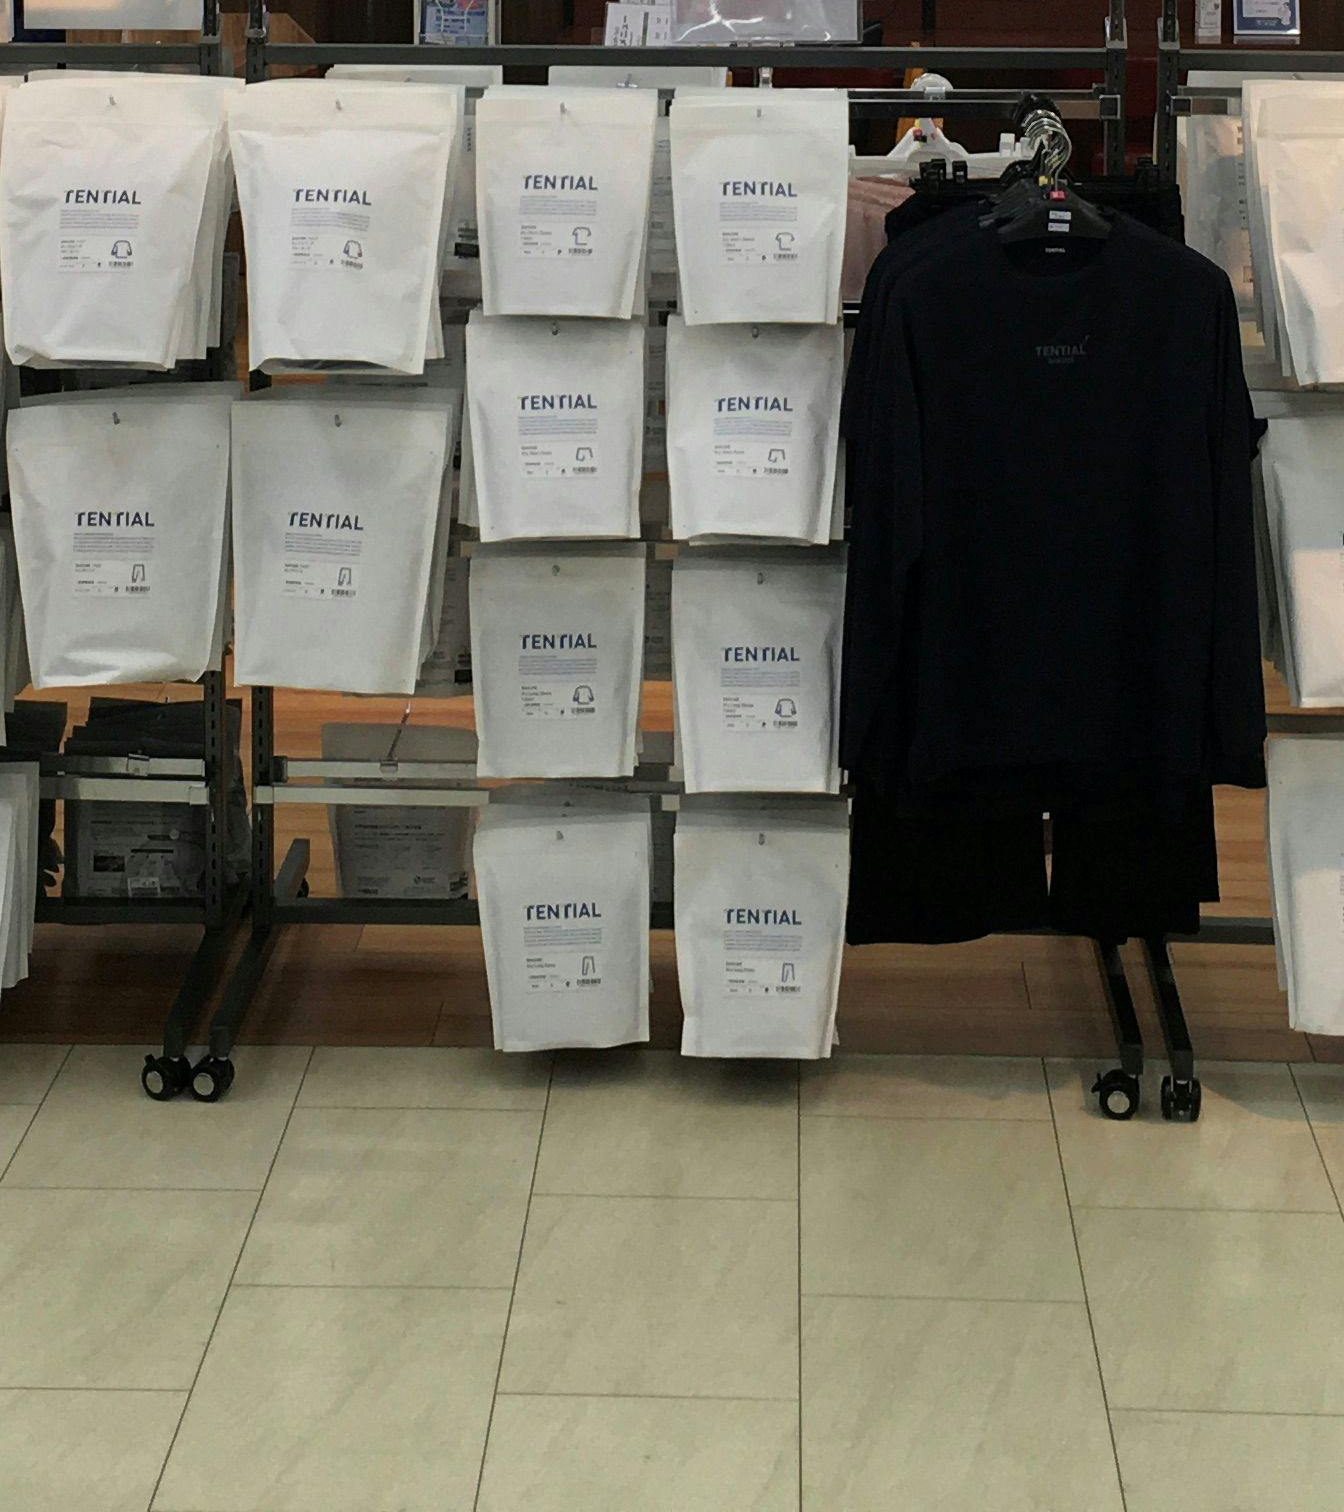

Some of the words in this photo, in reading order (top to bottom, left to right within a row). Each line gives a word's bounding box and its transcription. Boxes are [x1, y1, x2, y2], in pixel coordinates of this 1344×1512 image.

[522, 175, 597, 190] TENTIAL
[720, 181, 797, 197] TENTIAL
[63, 190, 141, 204] TENTIAL
[293, 189, 371, 206] TENTIAL
[518, 394, 597, 410] TENTIAL
[715, 397, 792, 412] TENTIAL
[75, 511, 154, 527] TENTIAL
[287, 512, 363, 530] TENTIAL
[520, 633, 597, 649] TENTIAL
[722, 647, 799, 662] TENTIAL
[524, 903, 601, 921] TENTIAL
[724, 909, 802, 925] TENTIAL
